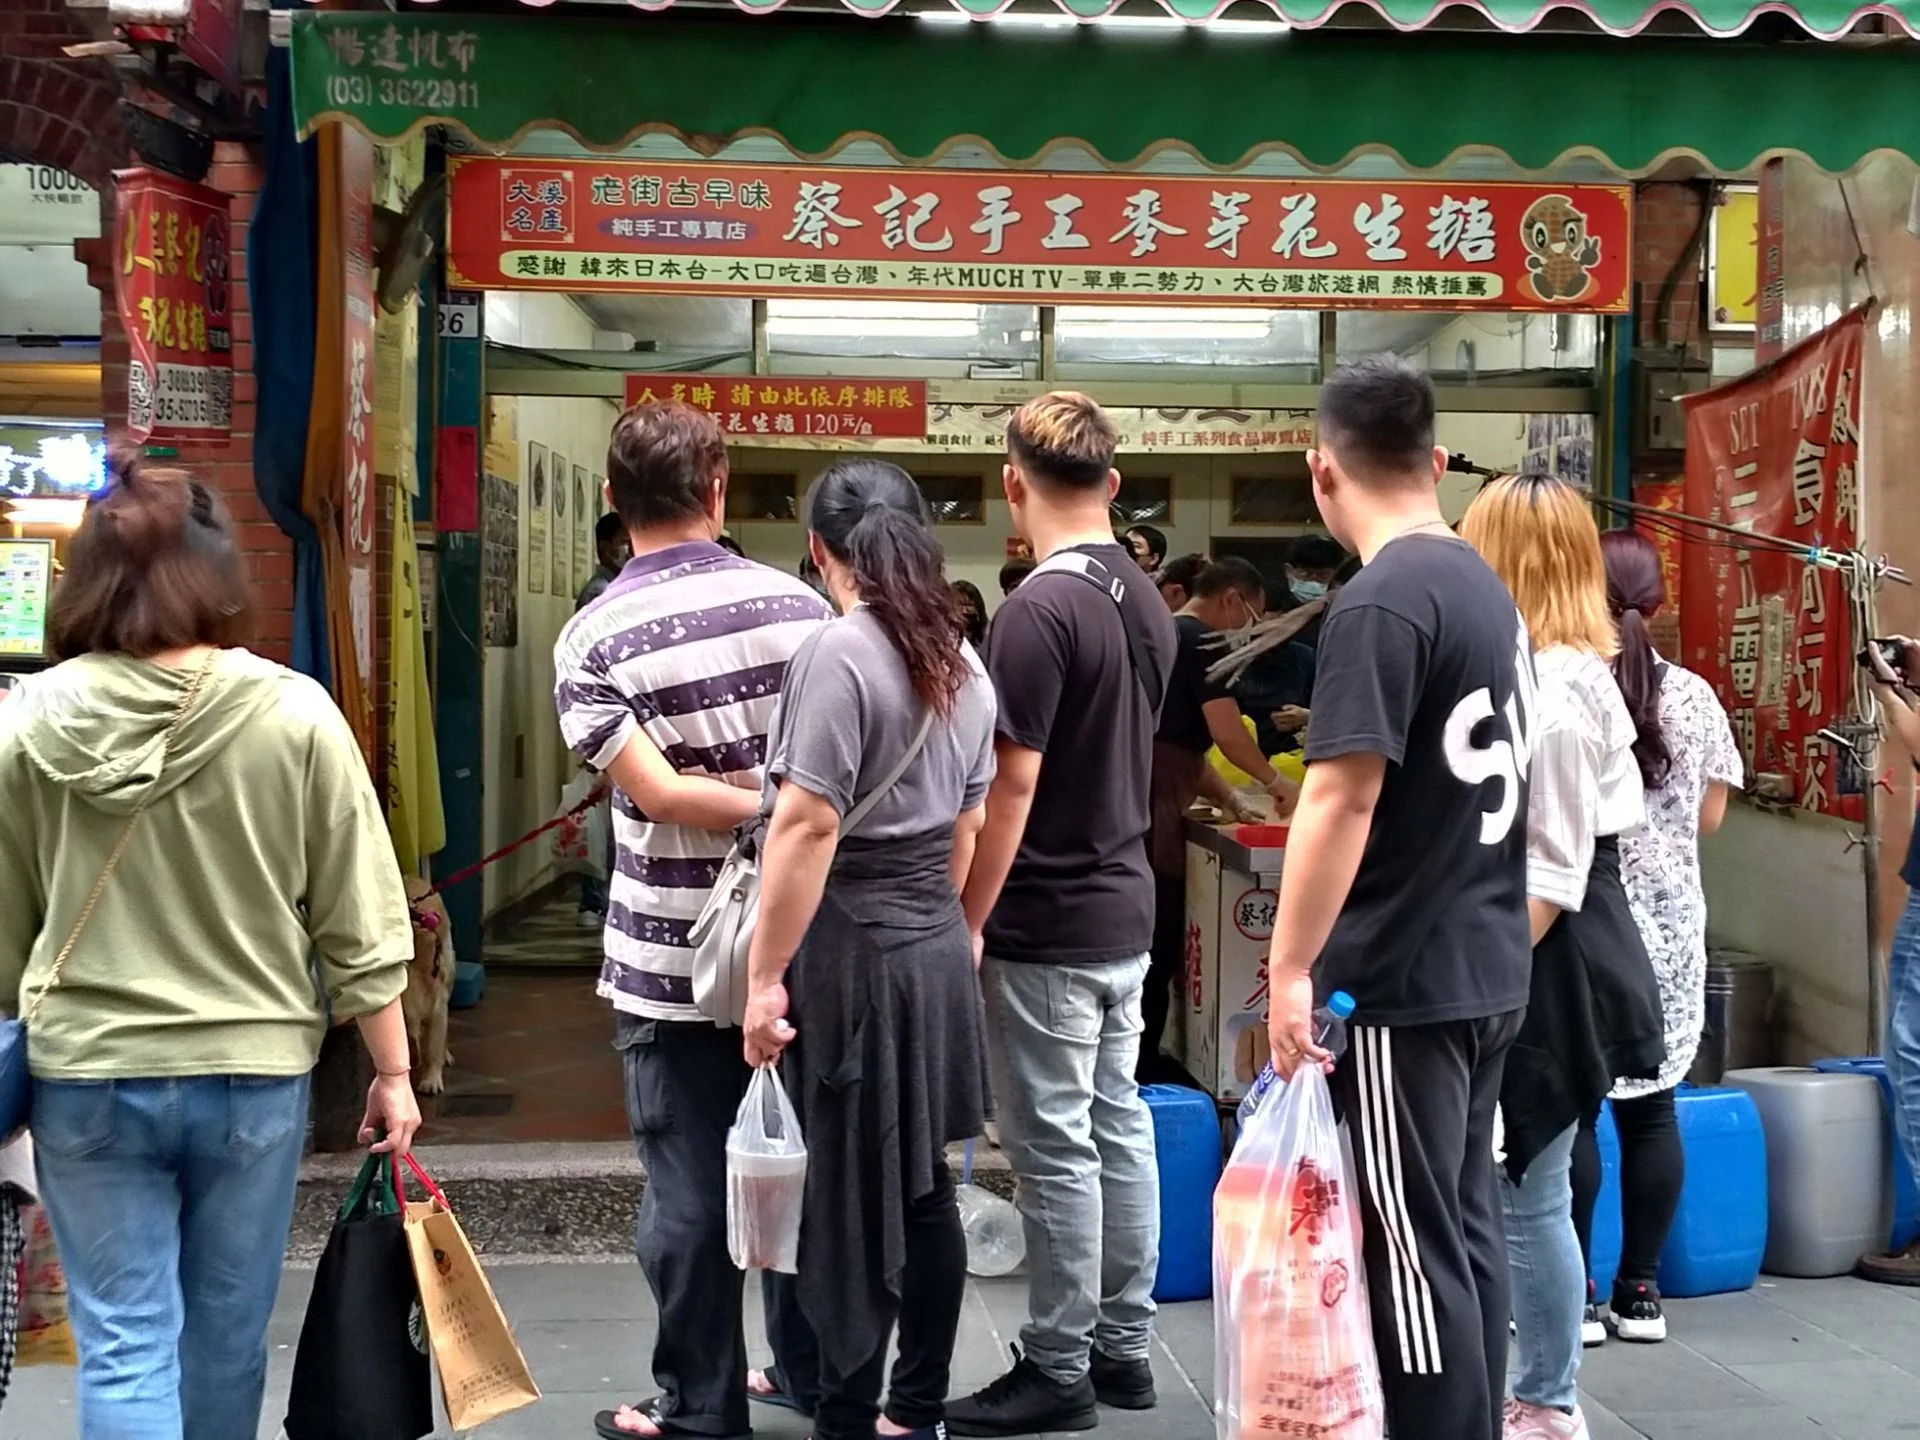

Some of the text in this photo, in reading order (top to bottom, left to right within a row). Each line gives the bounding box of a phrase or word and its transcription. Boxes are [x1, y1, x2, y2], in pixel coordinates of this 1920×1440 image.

[326, 75, 479, 109] (03) 3622911
[507, 180, 567, 204] 大溪
[591, 175, 771, 210] 老街古早味
[507, 208, 567, 232] 名產
[611, 217, 748, 241] 純手工專賣店
[782, 180, 1496, 262] 蔡記手工麥芽花生糖
[516, 255, 567, 276] 感謝
[1391, 275, 1487, 297] 熱情推薦
[731, 383, 914, 409] 請由此依序排隊
[1141, 429, 1312, 447] 純手工系列食品專賣店
